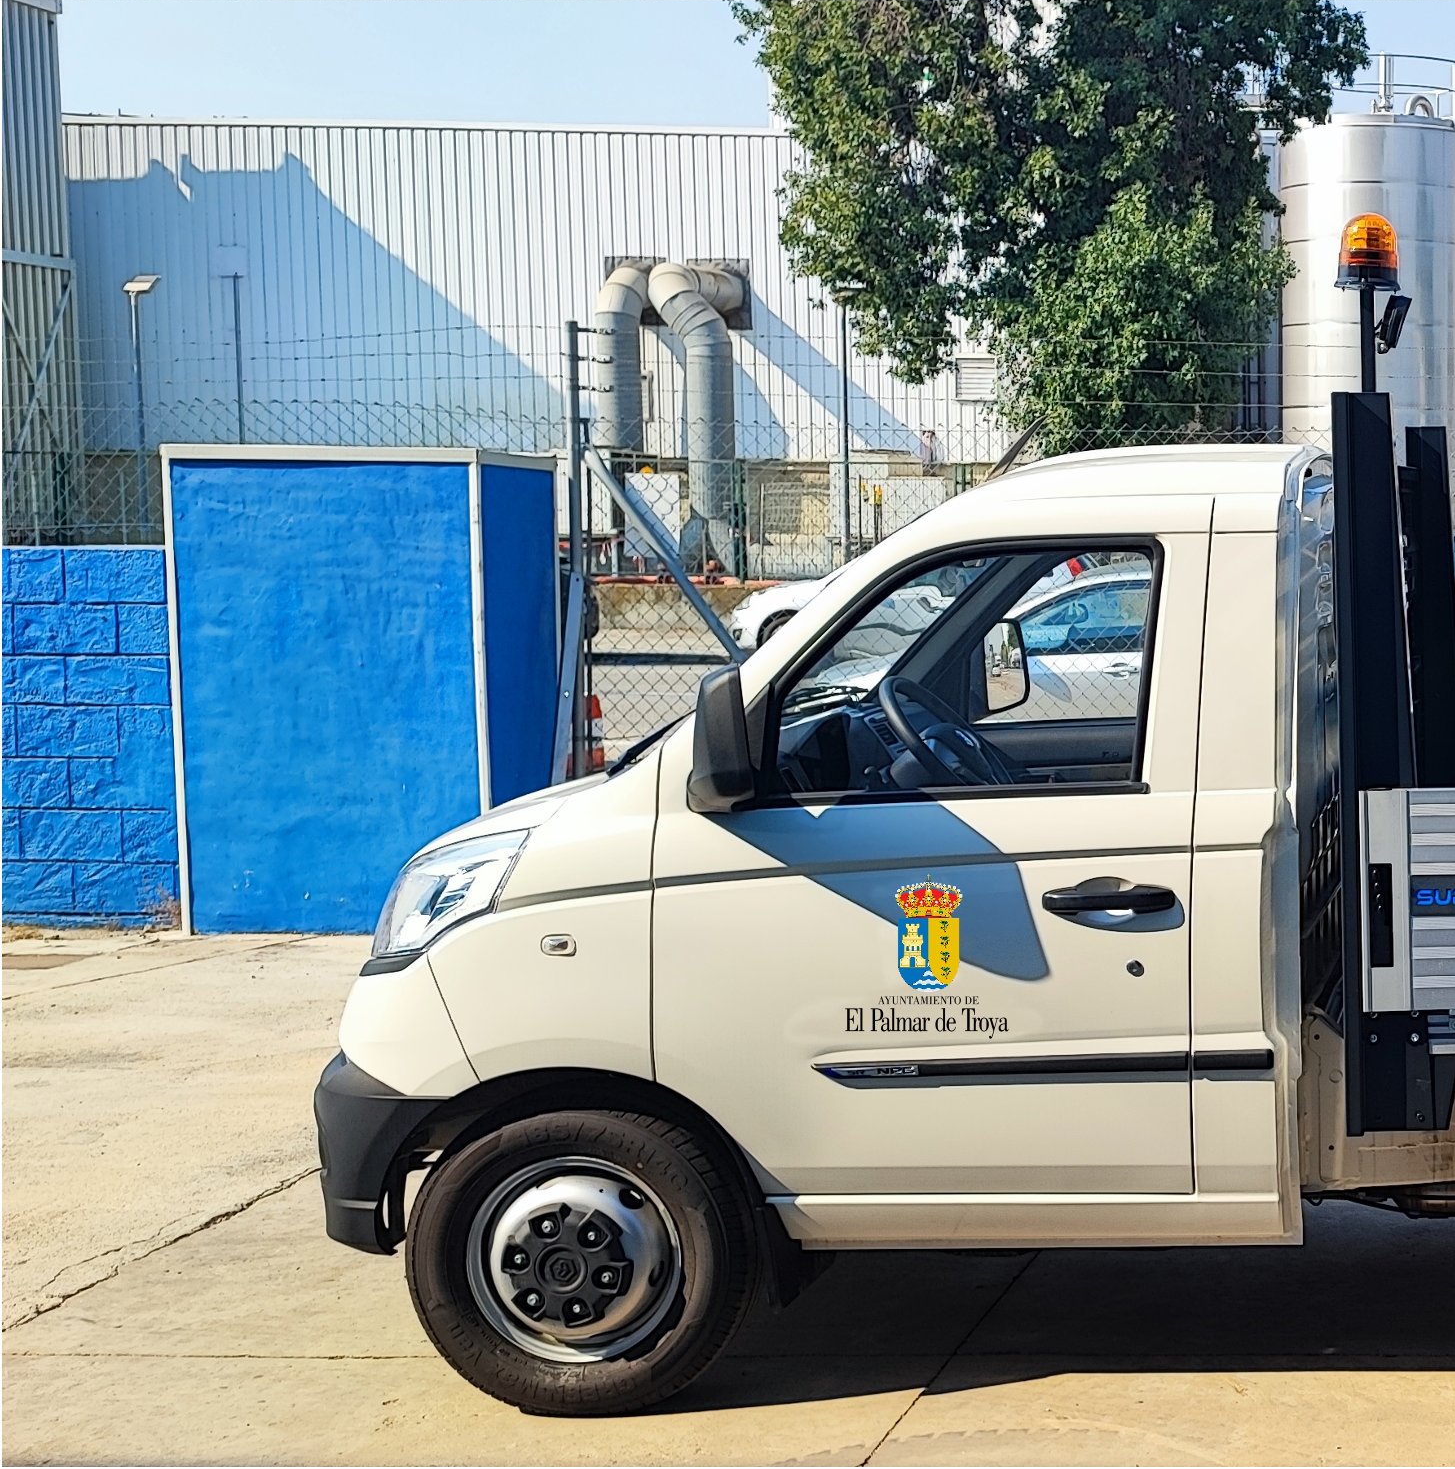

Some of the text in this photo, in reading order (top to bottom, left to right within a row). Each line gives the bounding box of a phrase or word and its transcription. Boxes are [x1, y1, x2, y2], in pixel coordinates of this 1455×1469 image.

[878, 996, 979, 1005] AYUNTAMIENTO DE
[845, 1008, 1009, 1039] El Palmar de Troya
